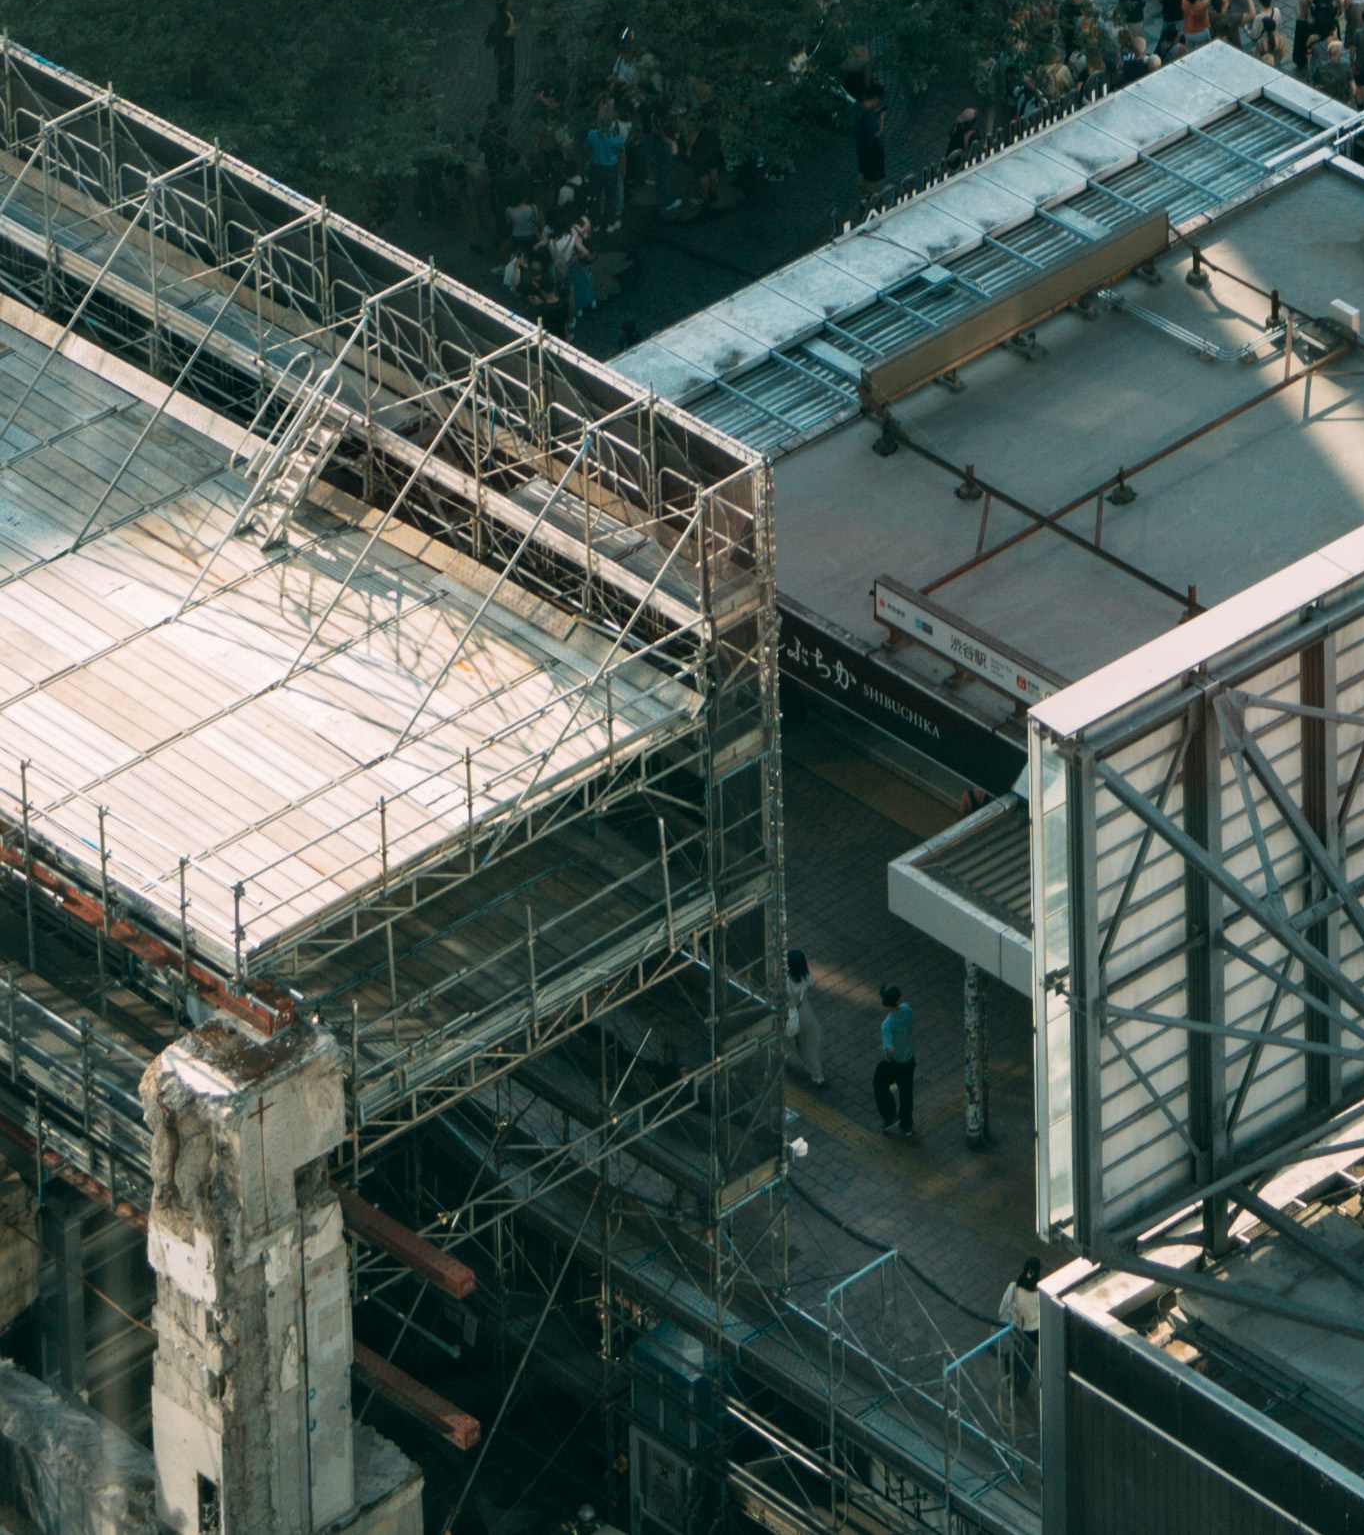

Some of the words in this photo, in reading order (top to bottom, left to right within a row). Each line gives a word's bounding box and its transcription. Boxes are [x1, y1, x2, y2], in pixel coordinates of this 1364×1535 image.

[950, 634, 989, 670] 渋谷駅
[863, 683, 940, 740] SHIBUCHIKA
